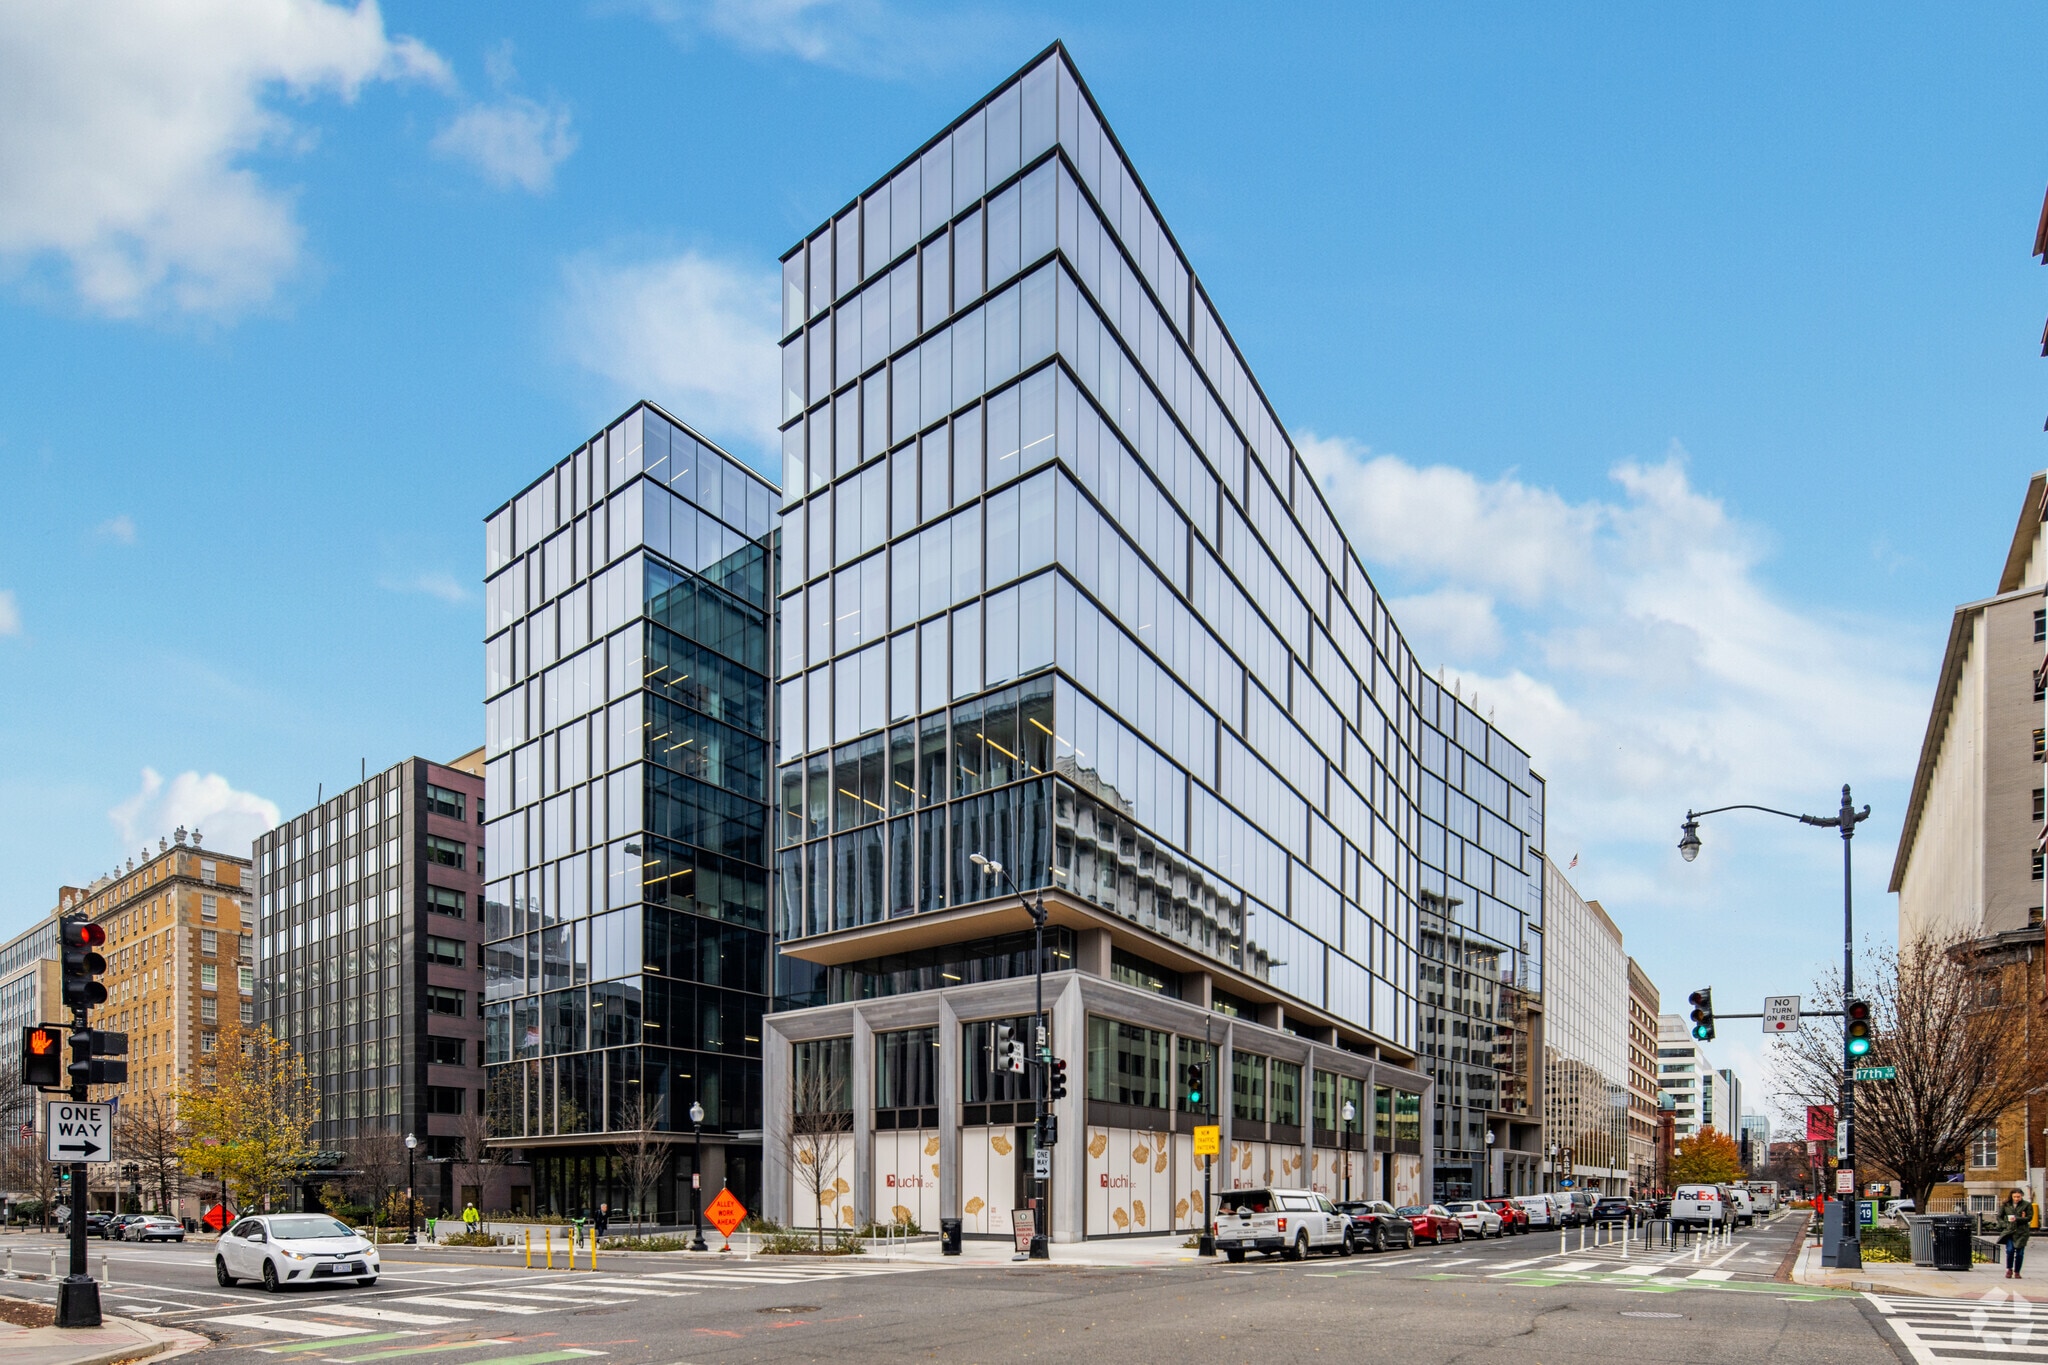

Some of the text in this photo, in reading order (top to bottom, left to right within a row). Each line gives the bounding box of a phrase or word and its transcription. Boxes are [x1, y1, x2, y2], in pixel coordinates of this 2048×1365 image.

[1774, 998, 1790, 1006] NO
[1857, 1069, 1882, 1079] 17th
[60, 1106, 101, 1121] ONE
[58, 1123, 102, 1137] WAY
[898, 1174, 923, 1188] uchi
[1109, 1174, 1129, 1188] uchi
[1678, 1190, 1715, 1201] FedEx
[1860, 1209, 1872, 1218] 19
